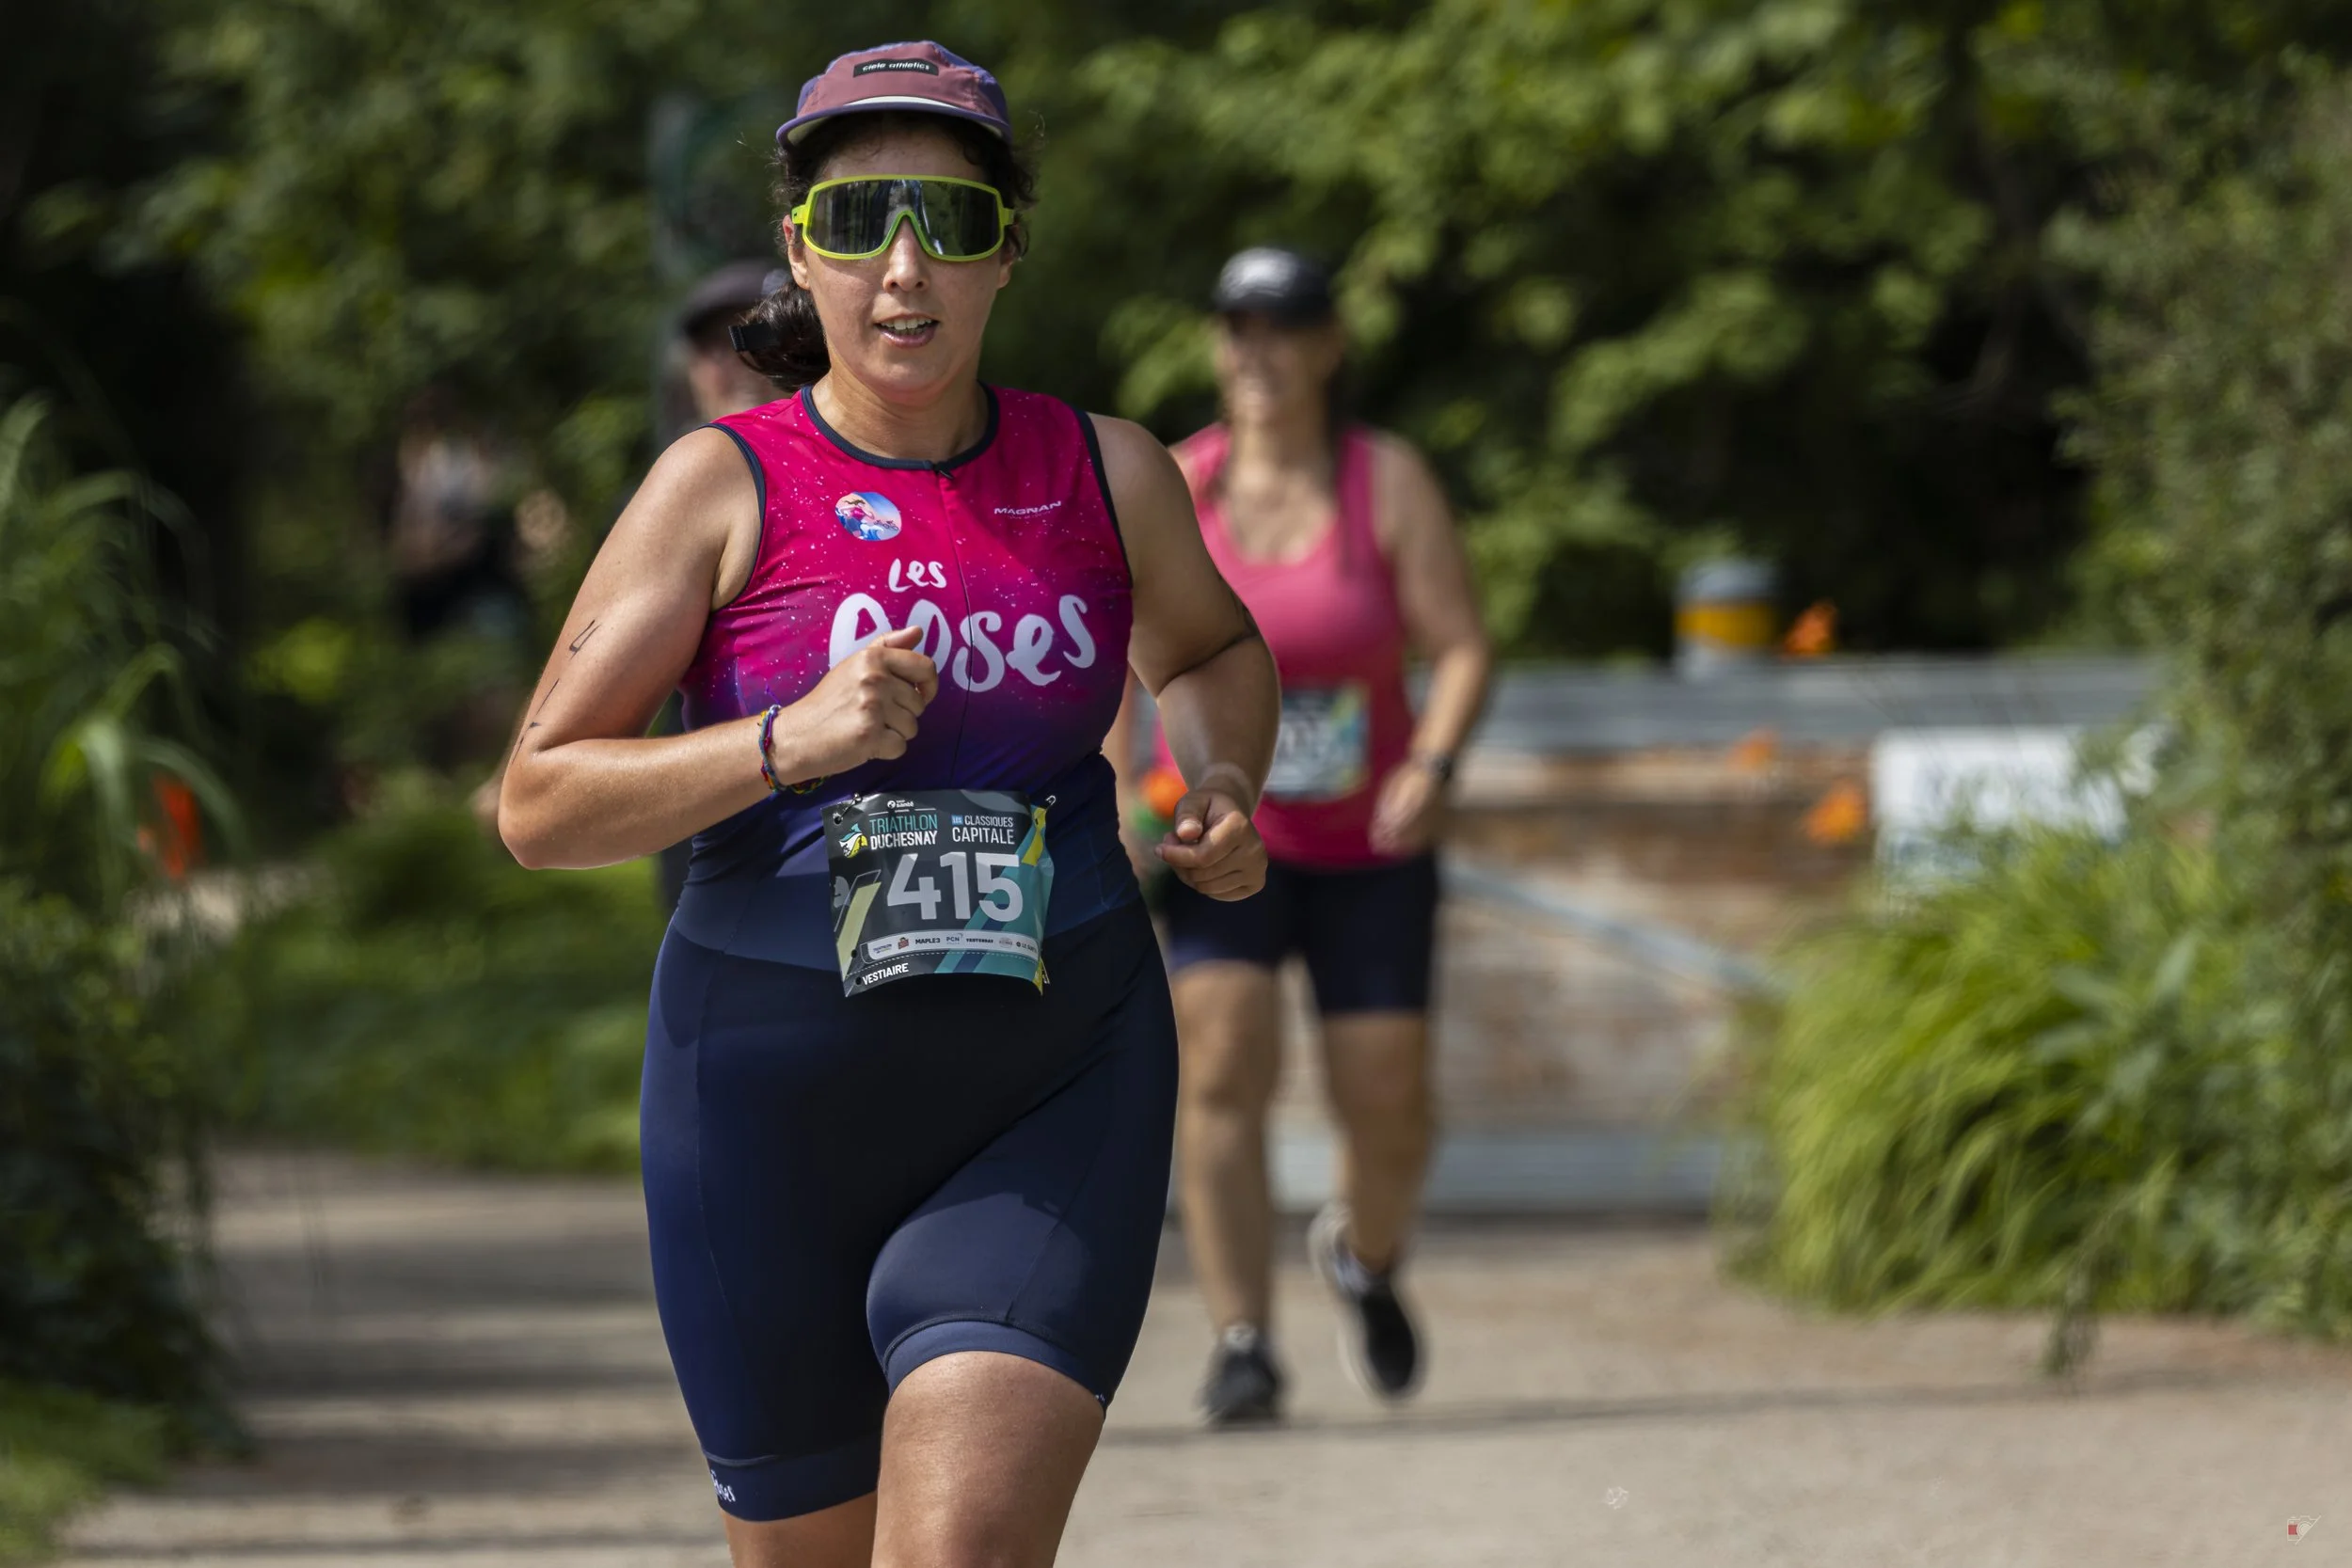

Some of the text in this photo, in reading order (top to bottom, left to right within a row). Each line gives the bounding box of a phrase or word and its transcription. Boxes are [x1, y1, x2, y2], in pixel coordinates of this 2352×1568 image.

[889, 62, 930, 71] athletics
[993, 500, 1062, 515] MAGNAN
[868, 814, 938, 834] TRIATHLON
[964, 815, 1014, 828] CLASSIQUES
[869, 830, 938, 850] DUCHESNAY
[952, 827, 1015, 845] CAPITALE
[887, 851, 1024, 922] 415
[862, 962, 909, 986] VESTIAIRE
